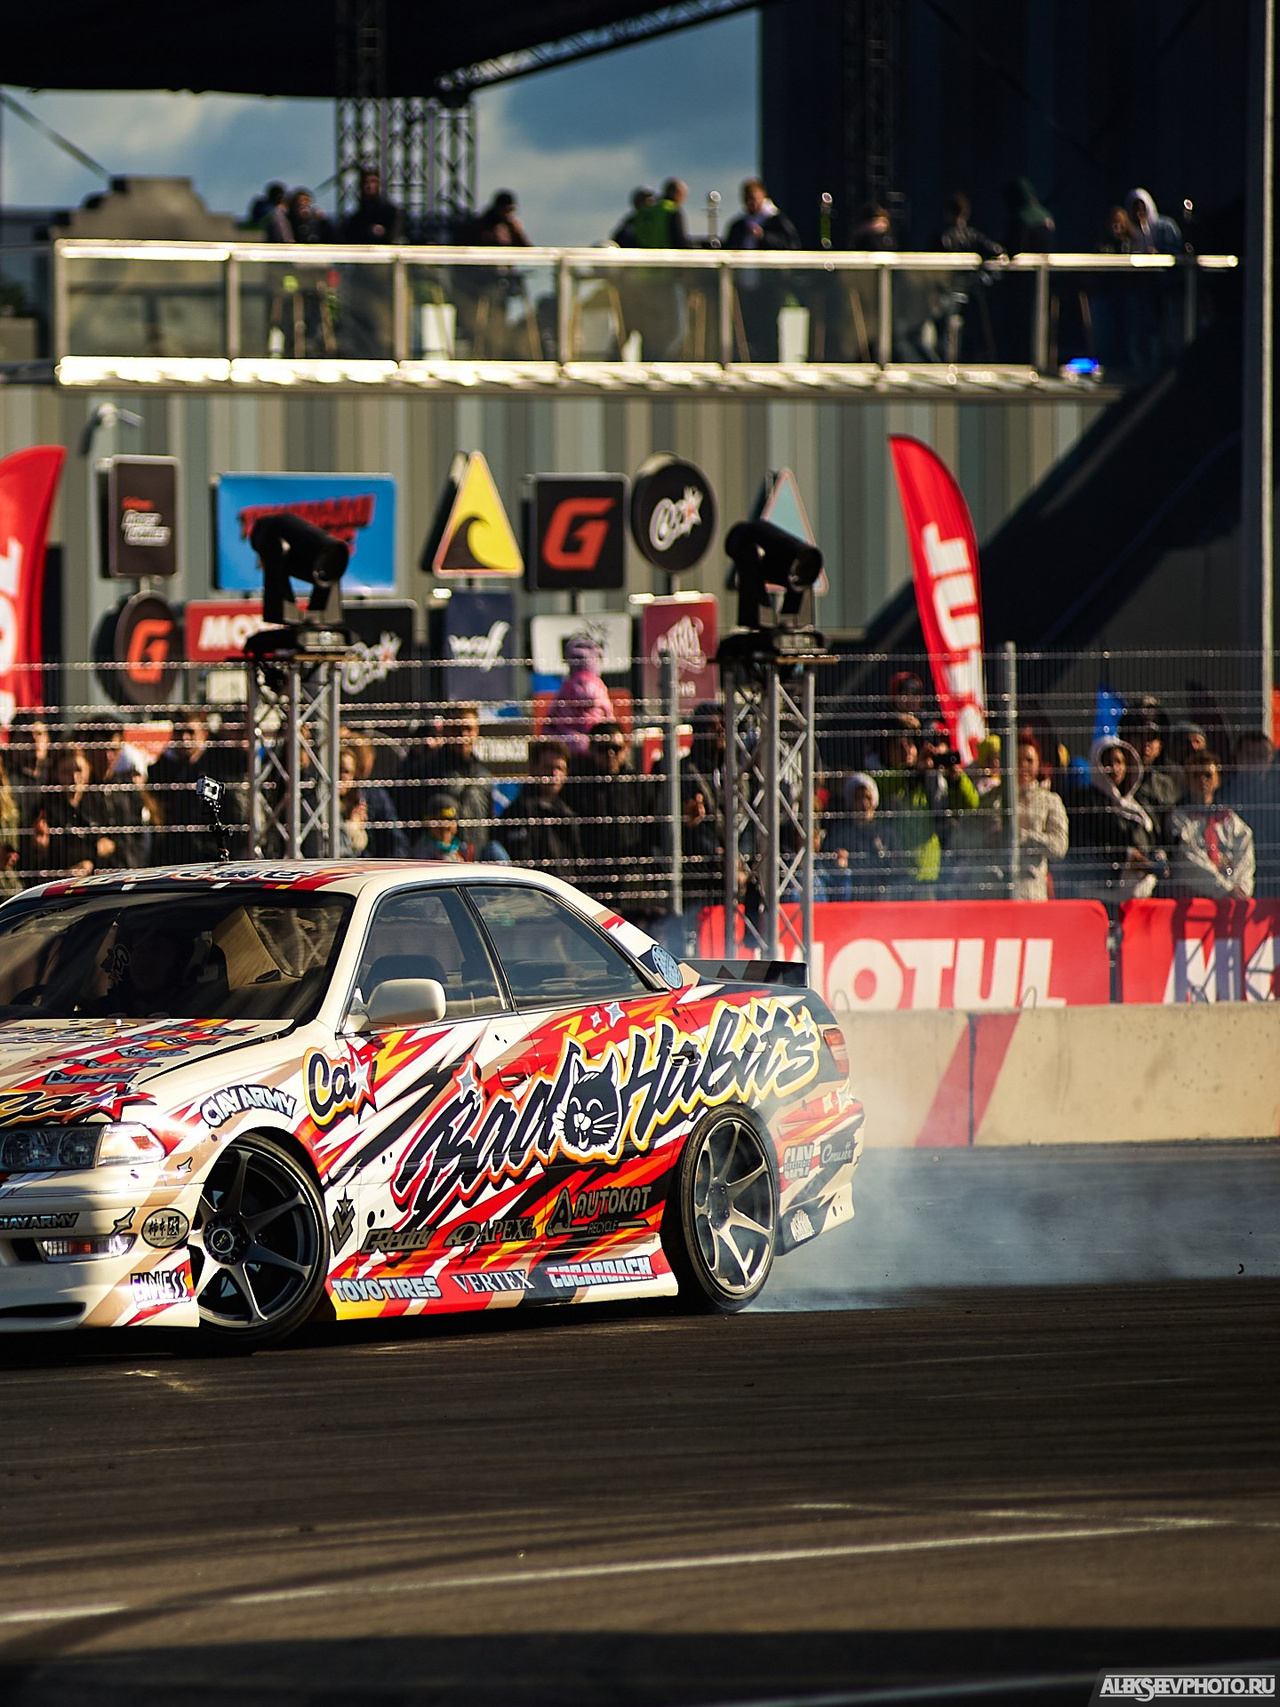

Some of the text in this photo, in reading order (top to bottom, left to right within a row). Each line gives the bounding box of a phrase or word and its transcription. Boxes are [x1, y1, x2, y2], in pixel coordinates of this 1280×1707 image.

[574, 1186, 652, 1218] AUTOKAT
[587, 1220, 618, 1234] RECYCLE
[331, 1276, 443, 1302] TOYO TIRES
[451, 1270, 536, 1294] VERTEX
